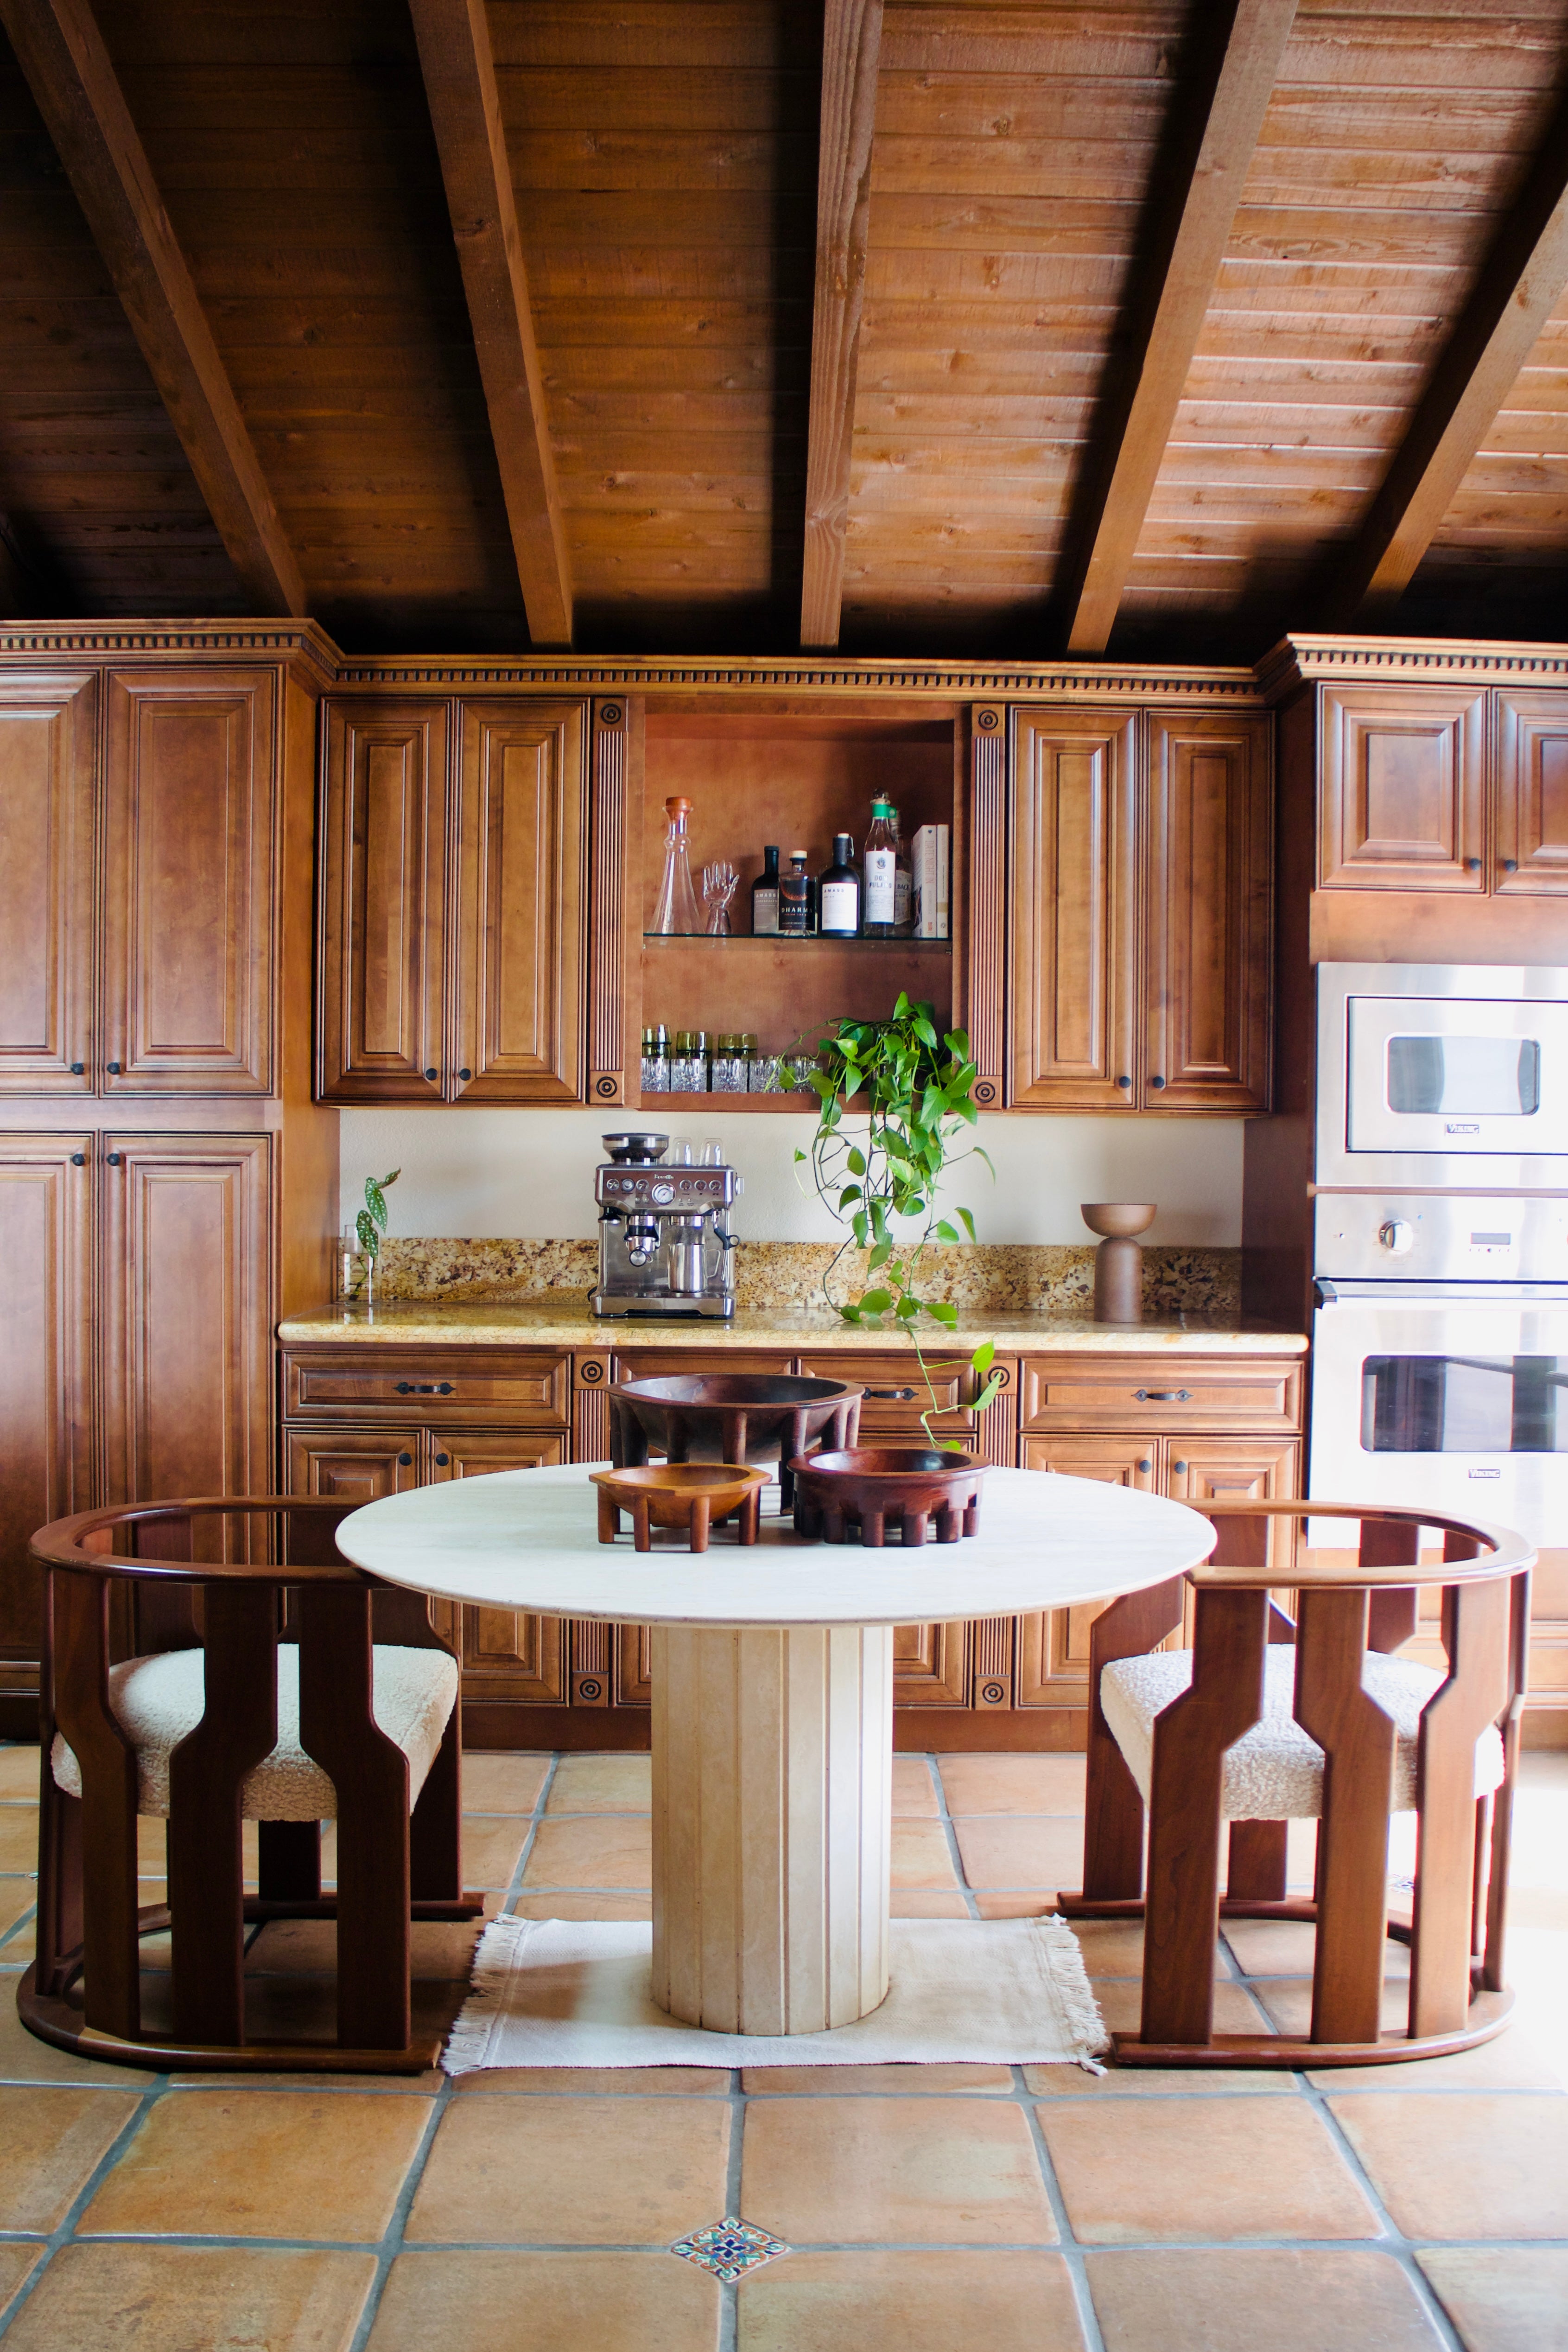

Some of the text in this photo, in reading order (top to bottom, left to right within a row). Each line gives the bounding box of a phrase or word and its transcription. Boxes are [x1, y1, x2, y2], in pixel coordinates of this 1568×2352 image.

[925, 840, 934, 856] DATE
[925, 858, 934, 875] NIGHT
[1447, 1124, 1479, 1133] VIKING
